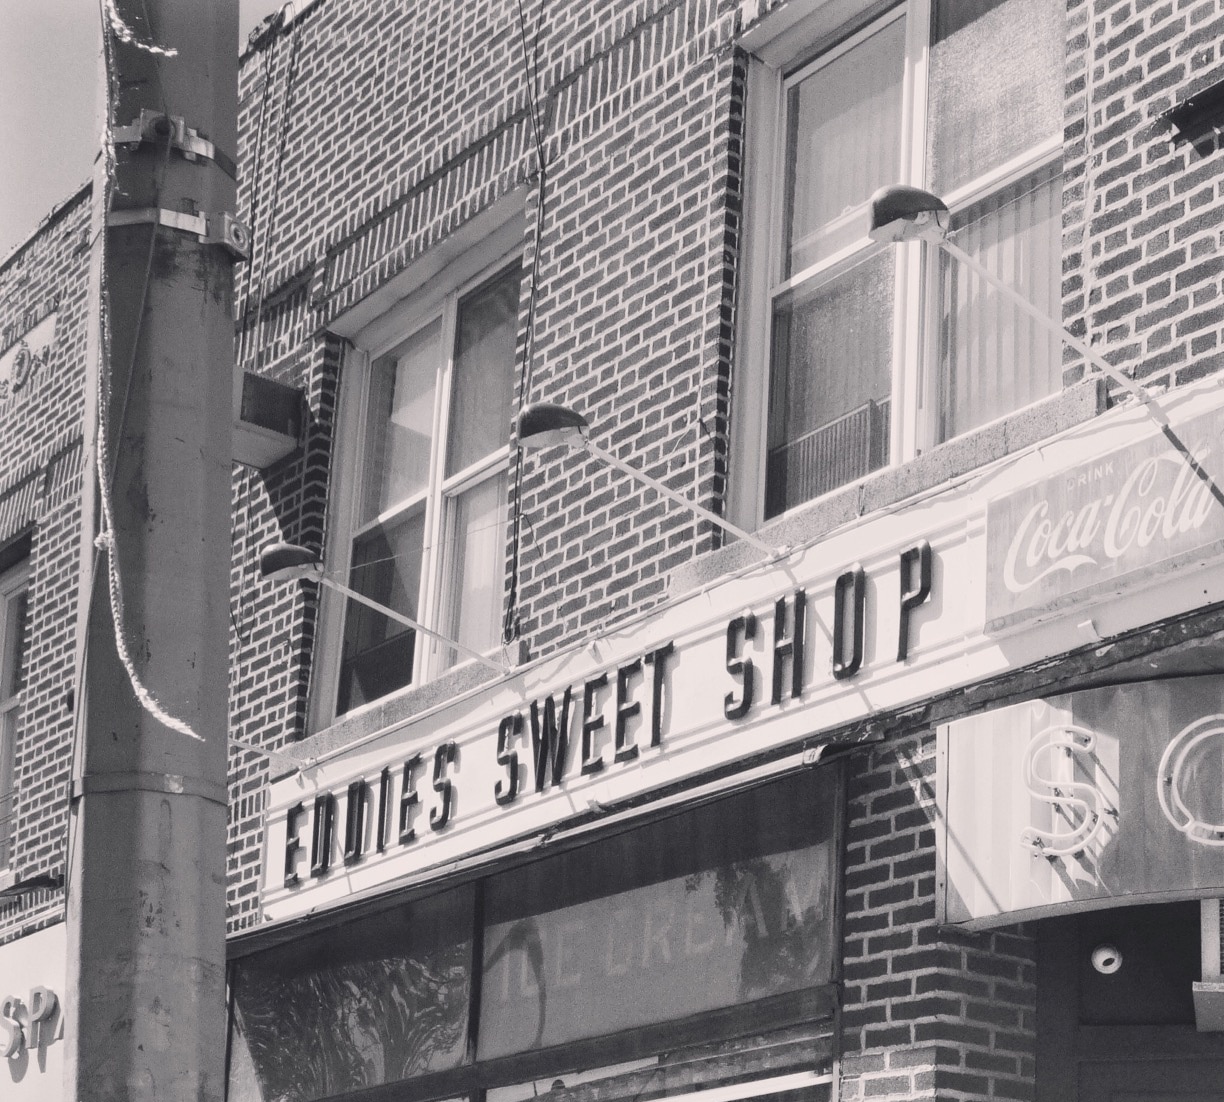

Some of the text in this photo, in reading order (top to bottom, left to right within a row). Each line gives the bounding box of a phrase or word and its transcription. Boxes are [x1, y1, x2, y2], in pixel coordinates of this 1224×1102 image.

[1003, 443, 1218, 595] Coca-Cola
[1066, 460, 1117, 494] DRINK
[283, 538, 934, 889] EDDIES SWEET SHOP
[0, 985, 64, 1057] SP
